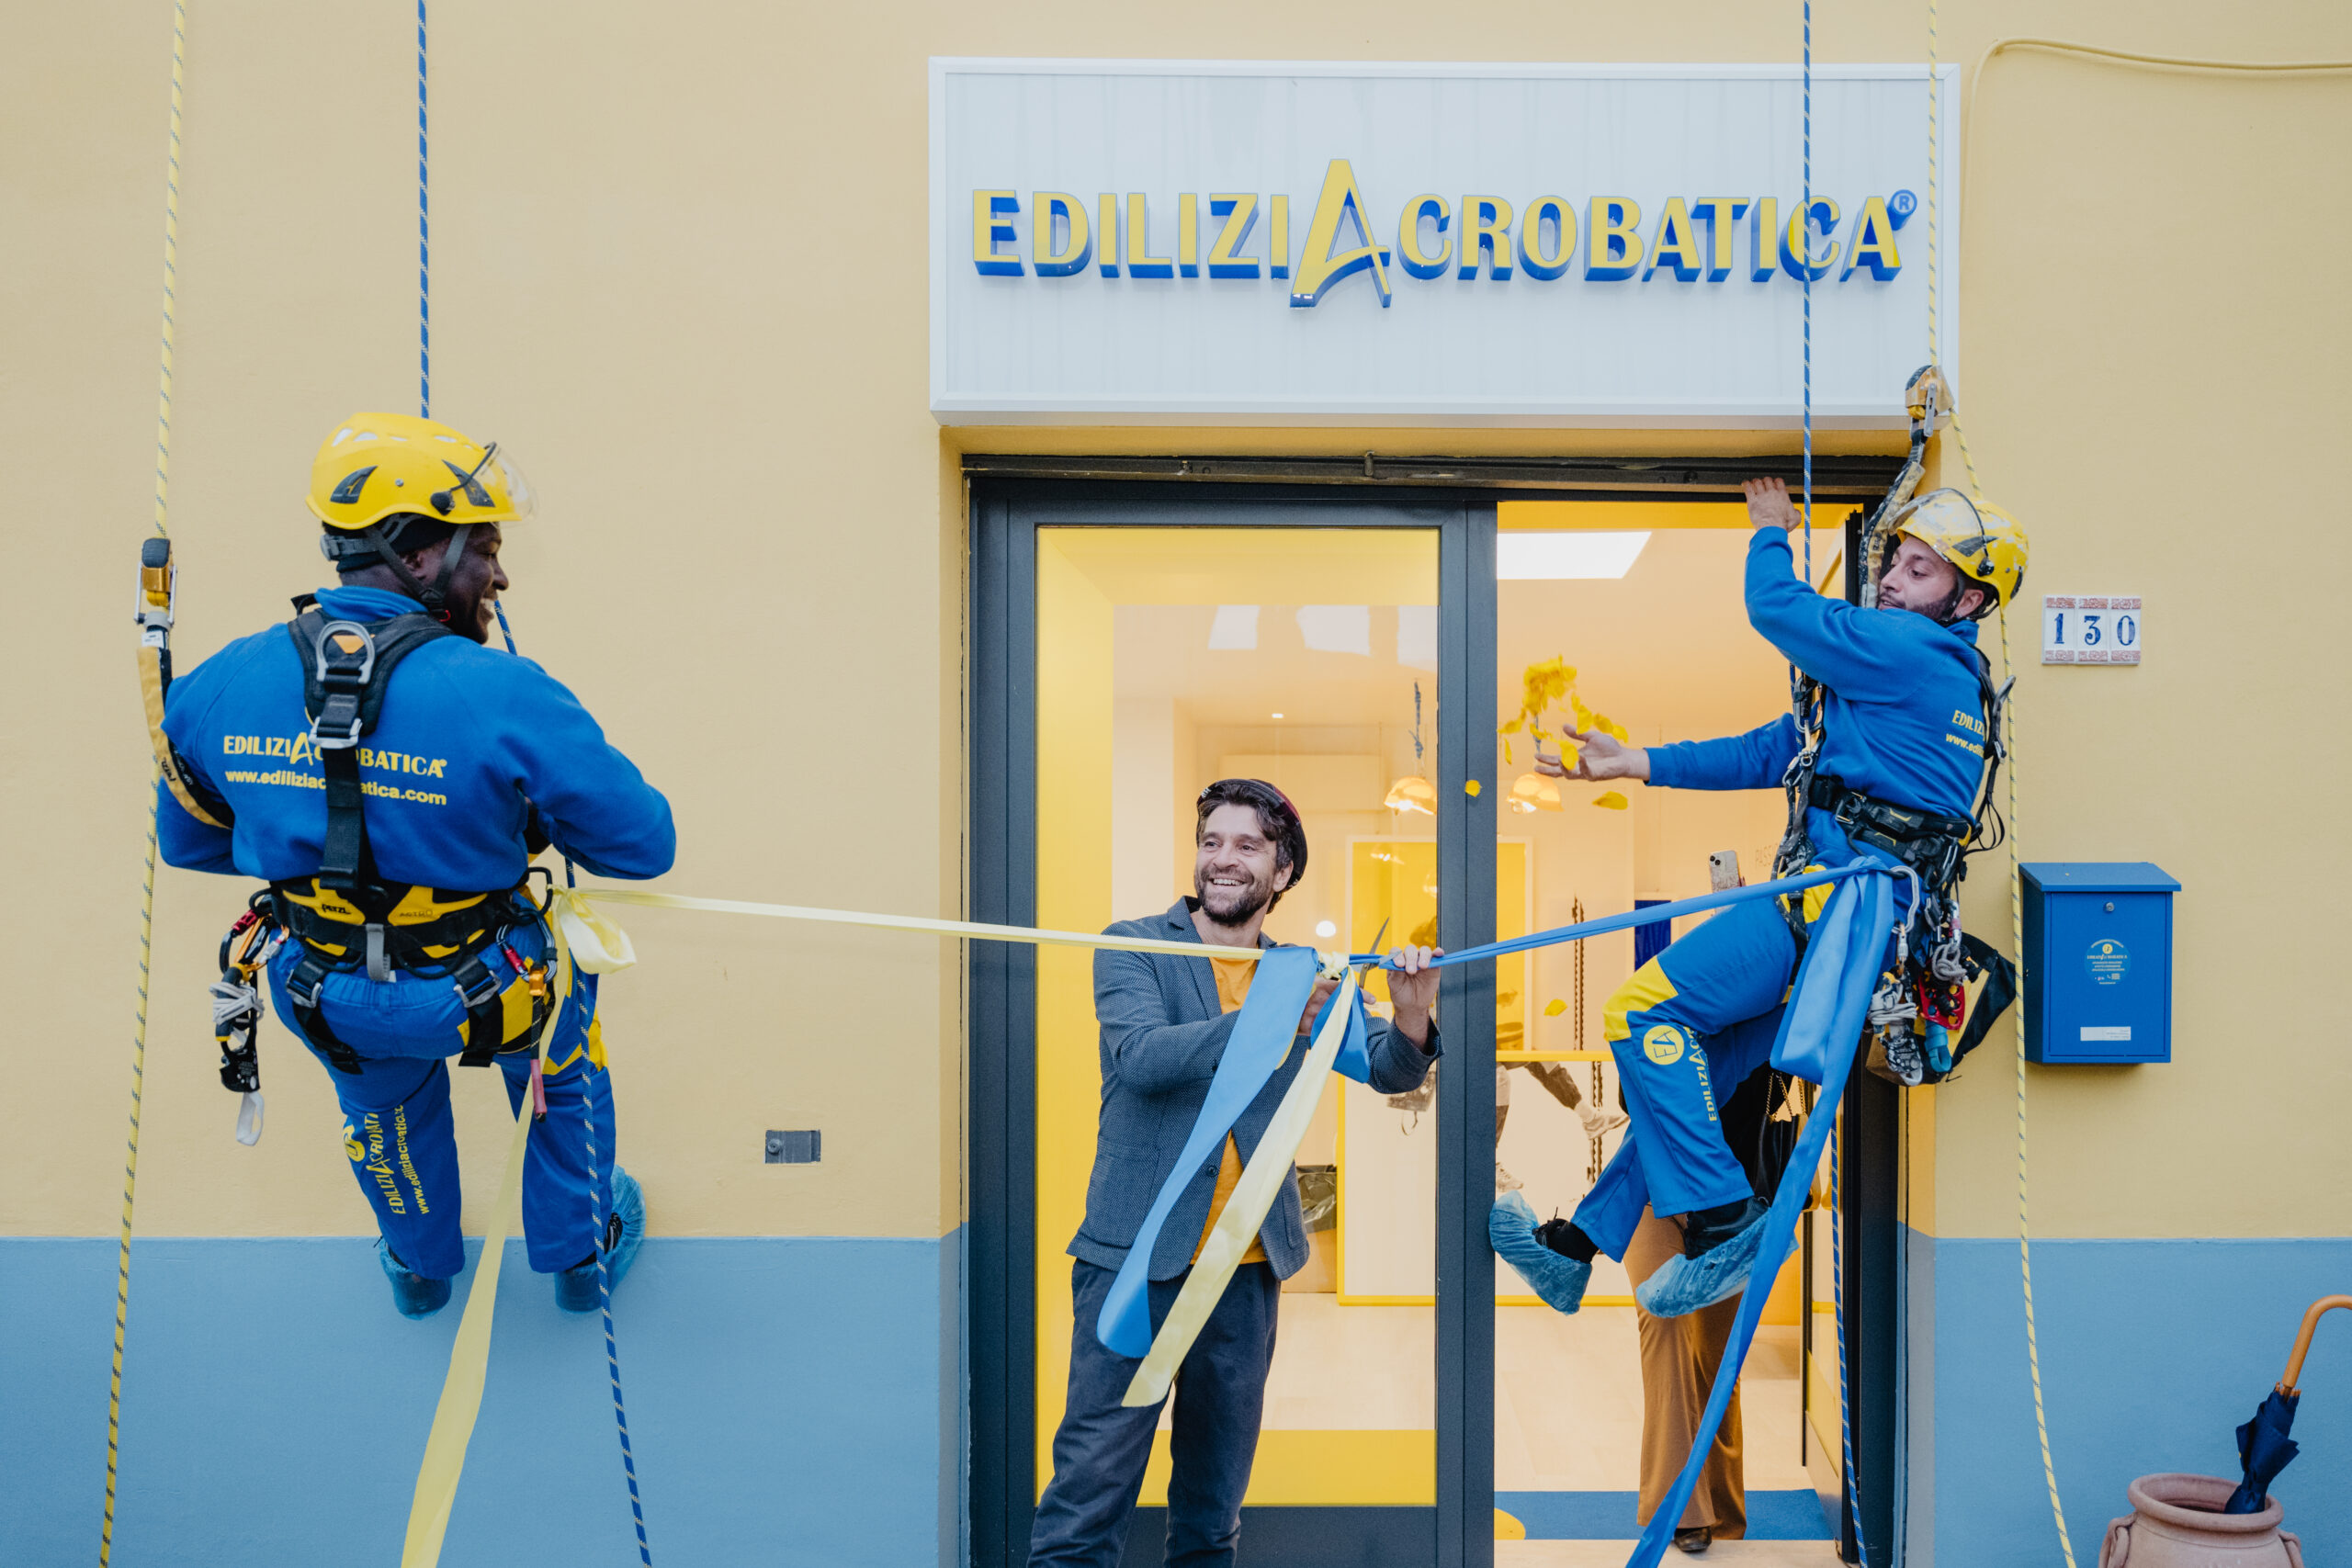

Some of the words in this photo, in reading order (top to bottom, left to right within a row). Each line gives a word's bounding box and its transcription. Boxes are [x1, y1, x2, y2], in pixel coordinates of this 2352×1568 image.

[2053, 613, 2136, 646] 130
[1951, 709, 1985, 741] EDILIZ
[225, 770, 447, 806] www.ediliziacatica.com
